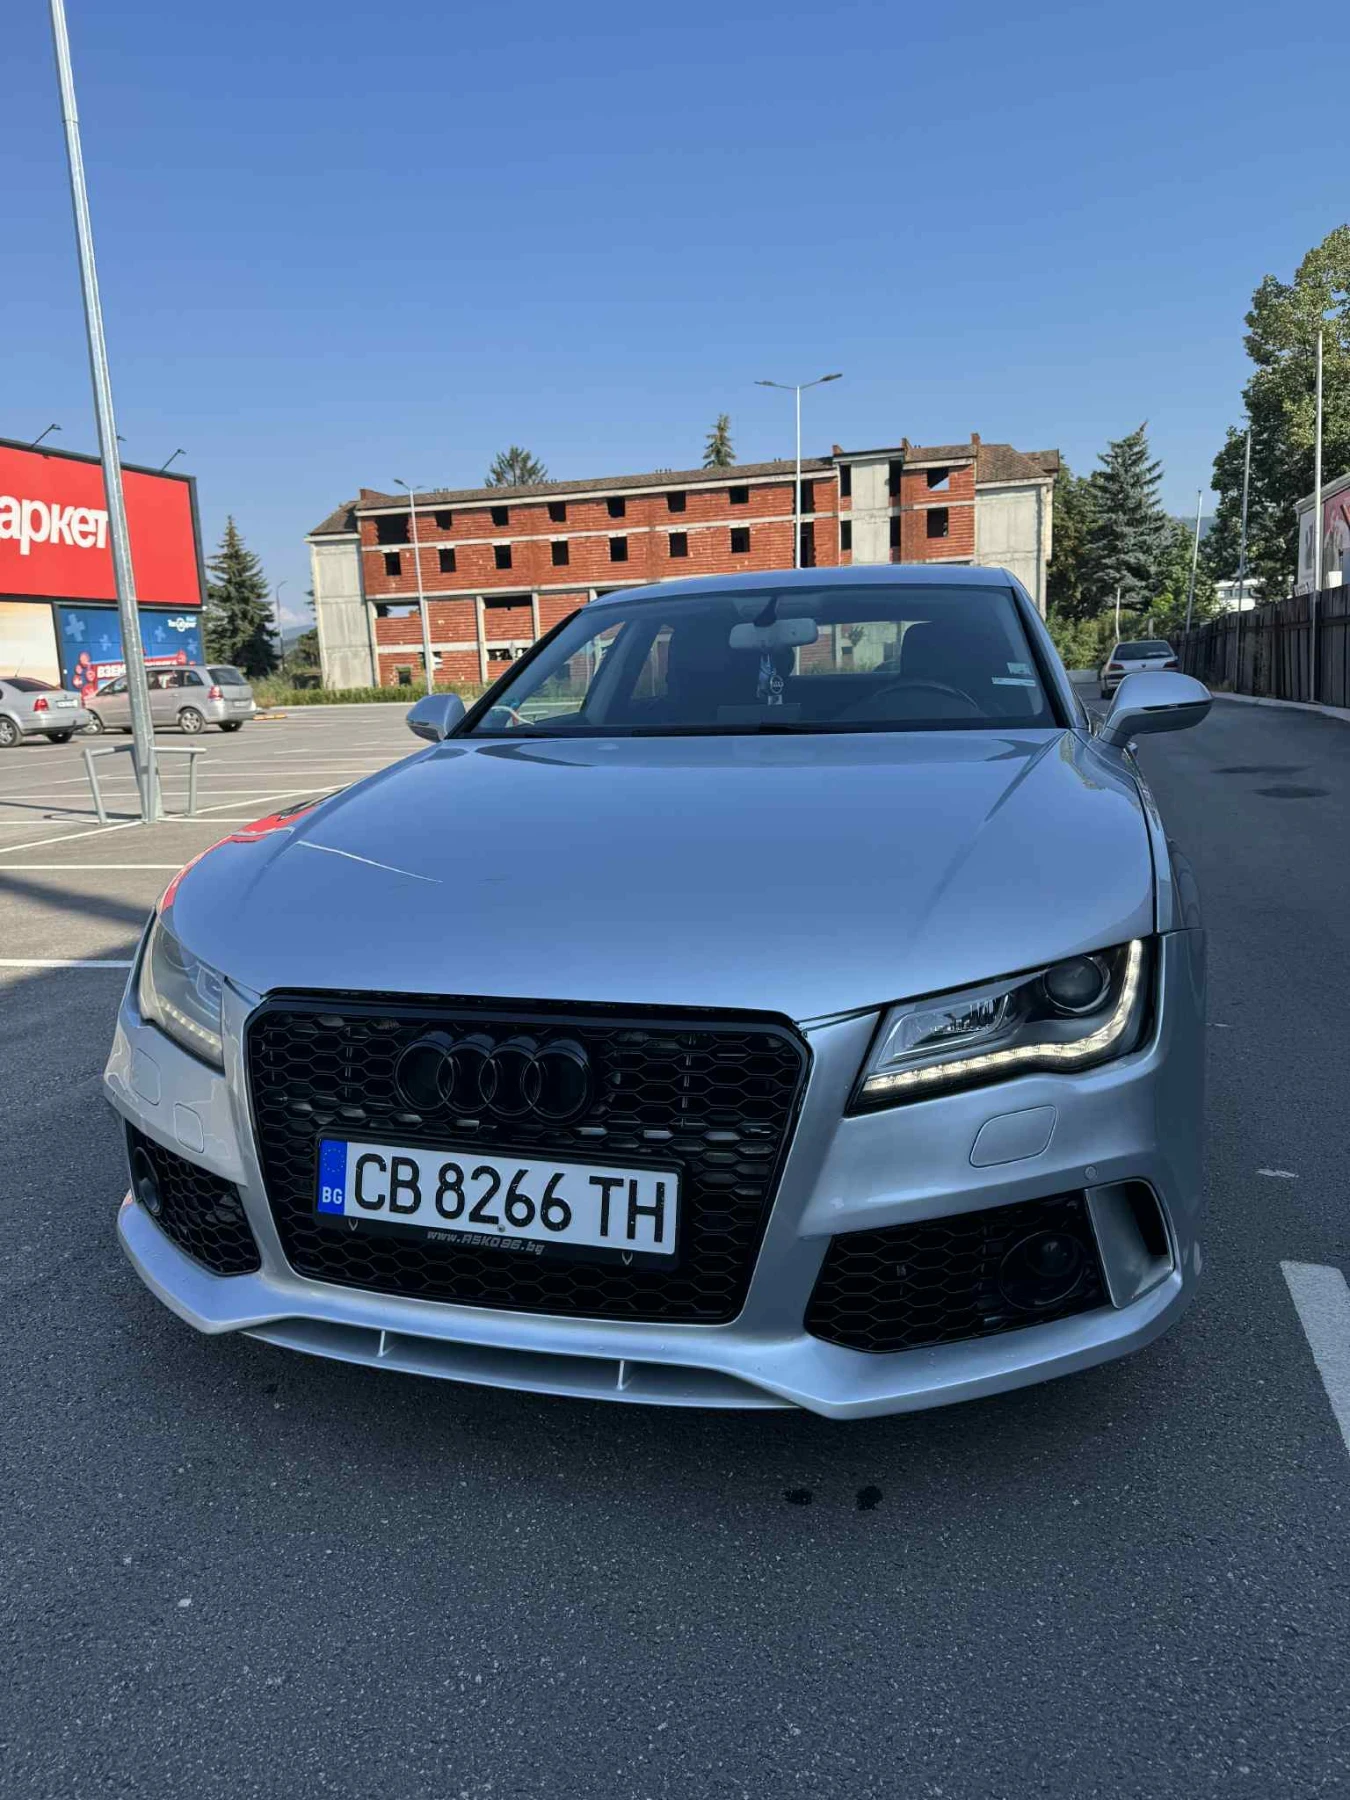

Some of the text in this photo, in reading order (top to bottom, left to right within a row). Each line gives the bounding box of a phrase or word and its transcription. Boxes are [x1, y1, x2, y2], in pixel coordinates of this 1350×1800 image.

[322, 1186, 343, 1205] BG
[354, 1152, 665, 1243] CB 8266 TH
